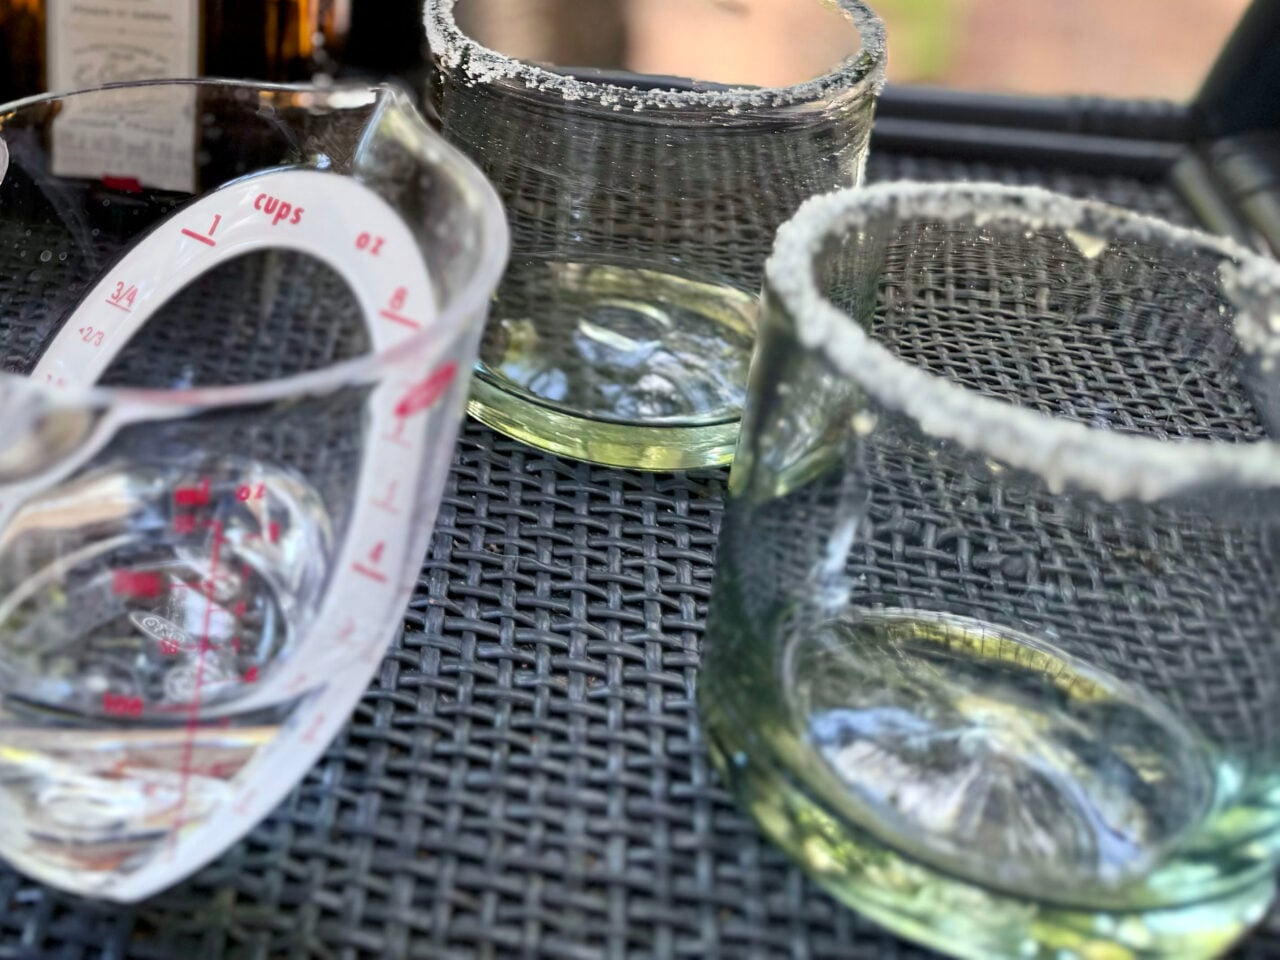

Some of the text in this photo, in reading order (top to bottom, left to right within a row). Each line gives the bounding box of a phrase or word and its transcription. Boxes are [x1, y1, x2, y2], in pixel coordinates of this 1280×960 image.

[254, 192, 305, 226] cups
[208, 214, 222, 236] 1
[354, 231, 386, 256] oz
[110, 280, 139, 308] 3/4
